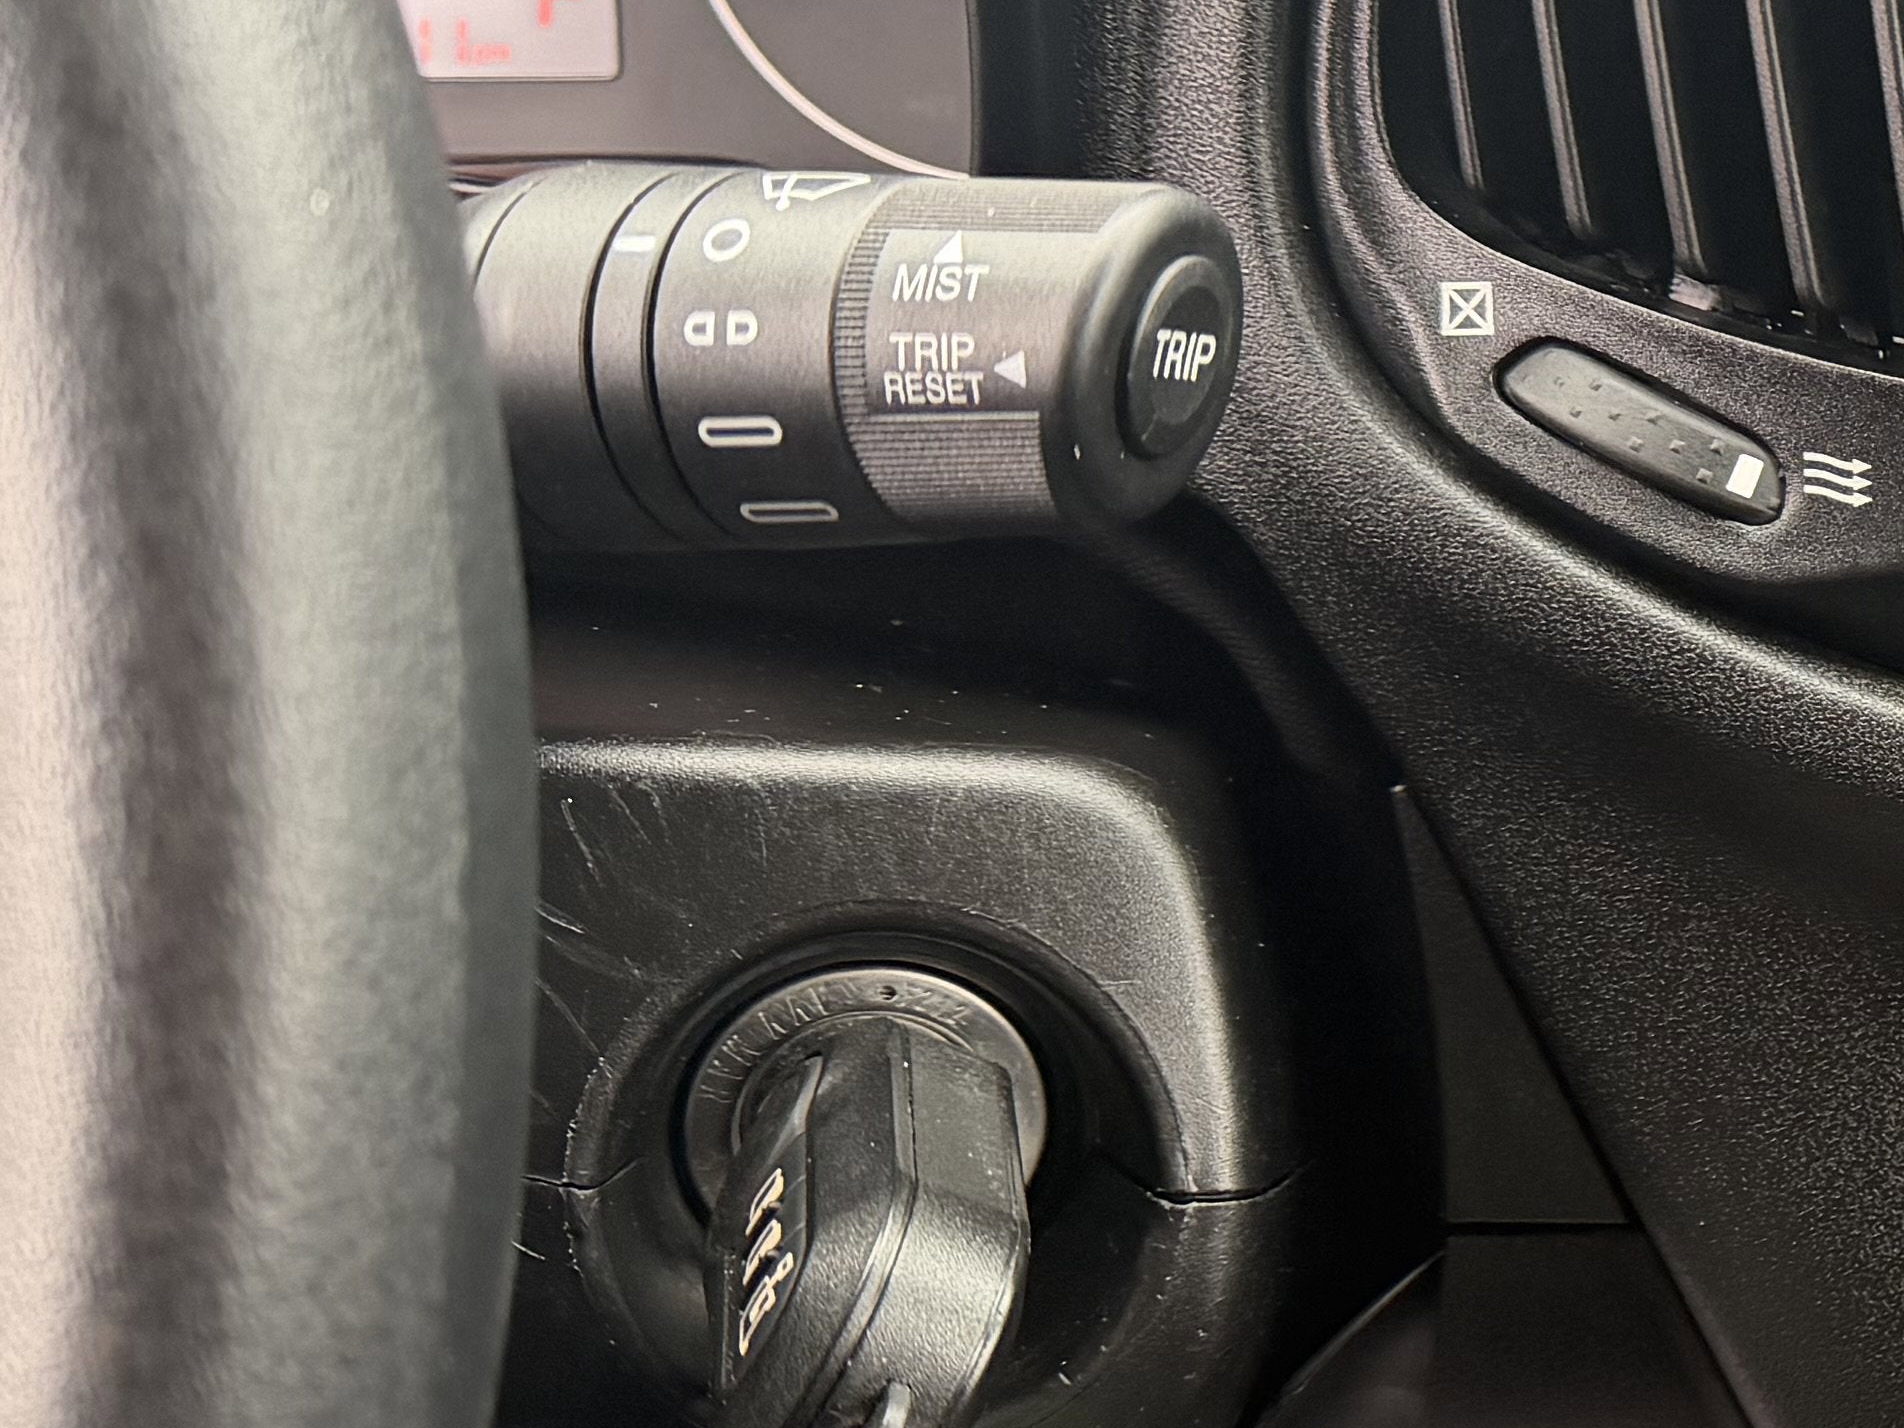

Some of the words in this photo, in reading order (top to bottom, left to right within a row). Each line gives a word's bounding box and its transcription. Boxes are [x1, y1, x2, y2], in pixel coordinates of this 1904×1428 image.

[891, 262, 991, 304] MIST
[889, 331, 976, 370] TRIP
[1151, 329, 1218, 383] TRIP
[883, 369, 985, 406] RESET
